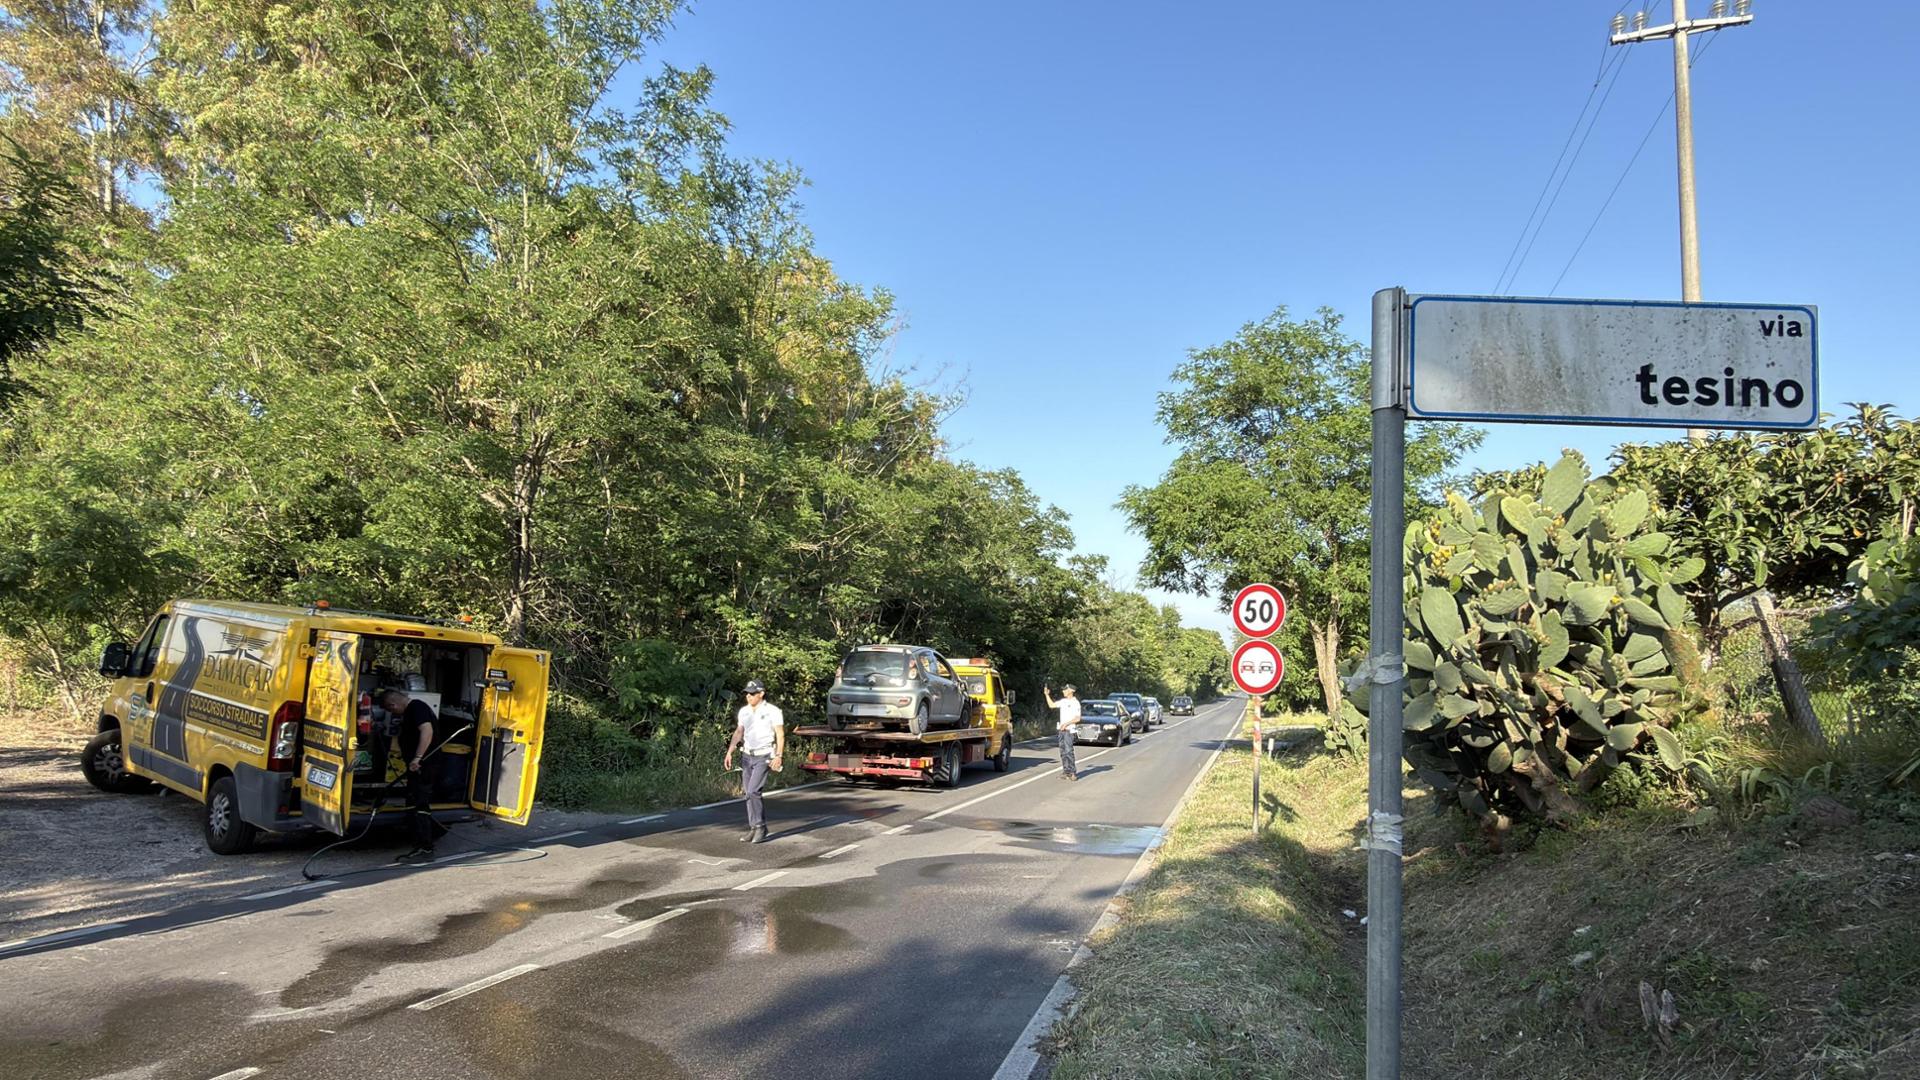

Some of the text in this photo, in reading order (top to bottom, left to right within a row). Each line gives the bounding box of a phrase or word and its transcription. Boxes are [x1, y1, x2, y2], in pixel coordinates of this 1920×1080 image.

[1759, 314, 1803, 338] via
[1635, 362, 1804, 409] tesino
[1244, 599, 1273, 623] 50
[203, 654, 273, 693] DAMACAR
[190, 695, 226, 717] SOCCORSO
[226, 705, 265, 729] STRADALE
